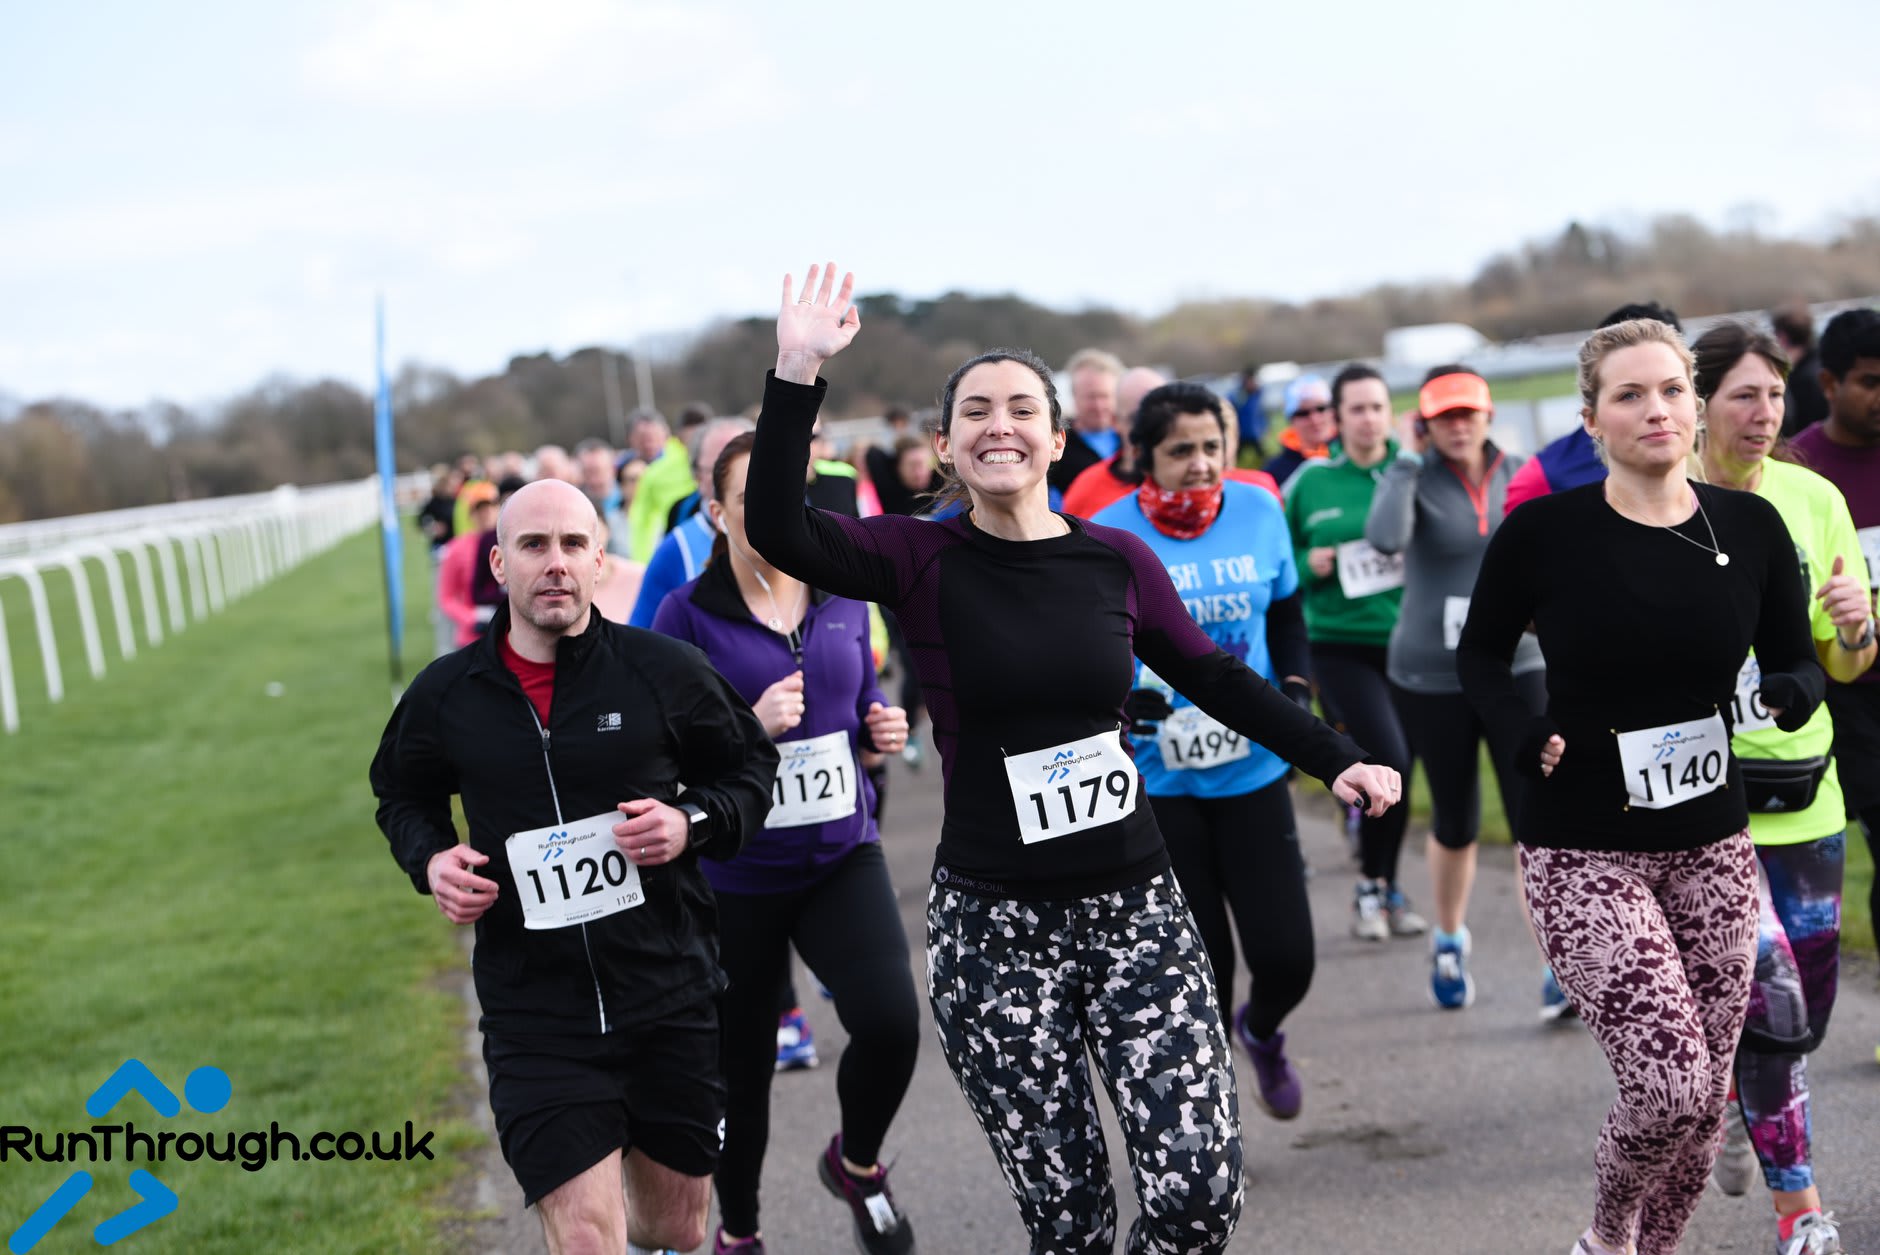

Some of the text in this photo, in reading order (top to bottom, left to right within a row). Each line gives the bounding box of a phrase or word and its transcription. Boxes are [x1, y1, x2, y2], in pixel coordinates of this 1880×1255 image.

[1210, 555, 1259, 586] FOR
[1042, 750, 1102, 771] RunThrough.co.uk
[1168, 729, 1239, 763] 1499
[775, 766, 844, 806] 1121
[1639, 750, 1722, 802] 1140
[1029, 770, 1130, 831] 1179
[527, 850, 627, 904] 1120
[950, 874, 1007, 893] STARK SOUL
[616, 892, 638, 906] 1120
